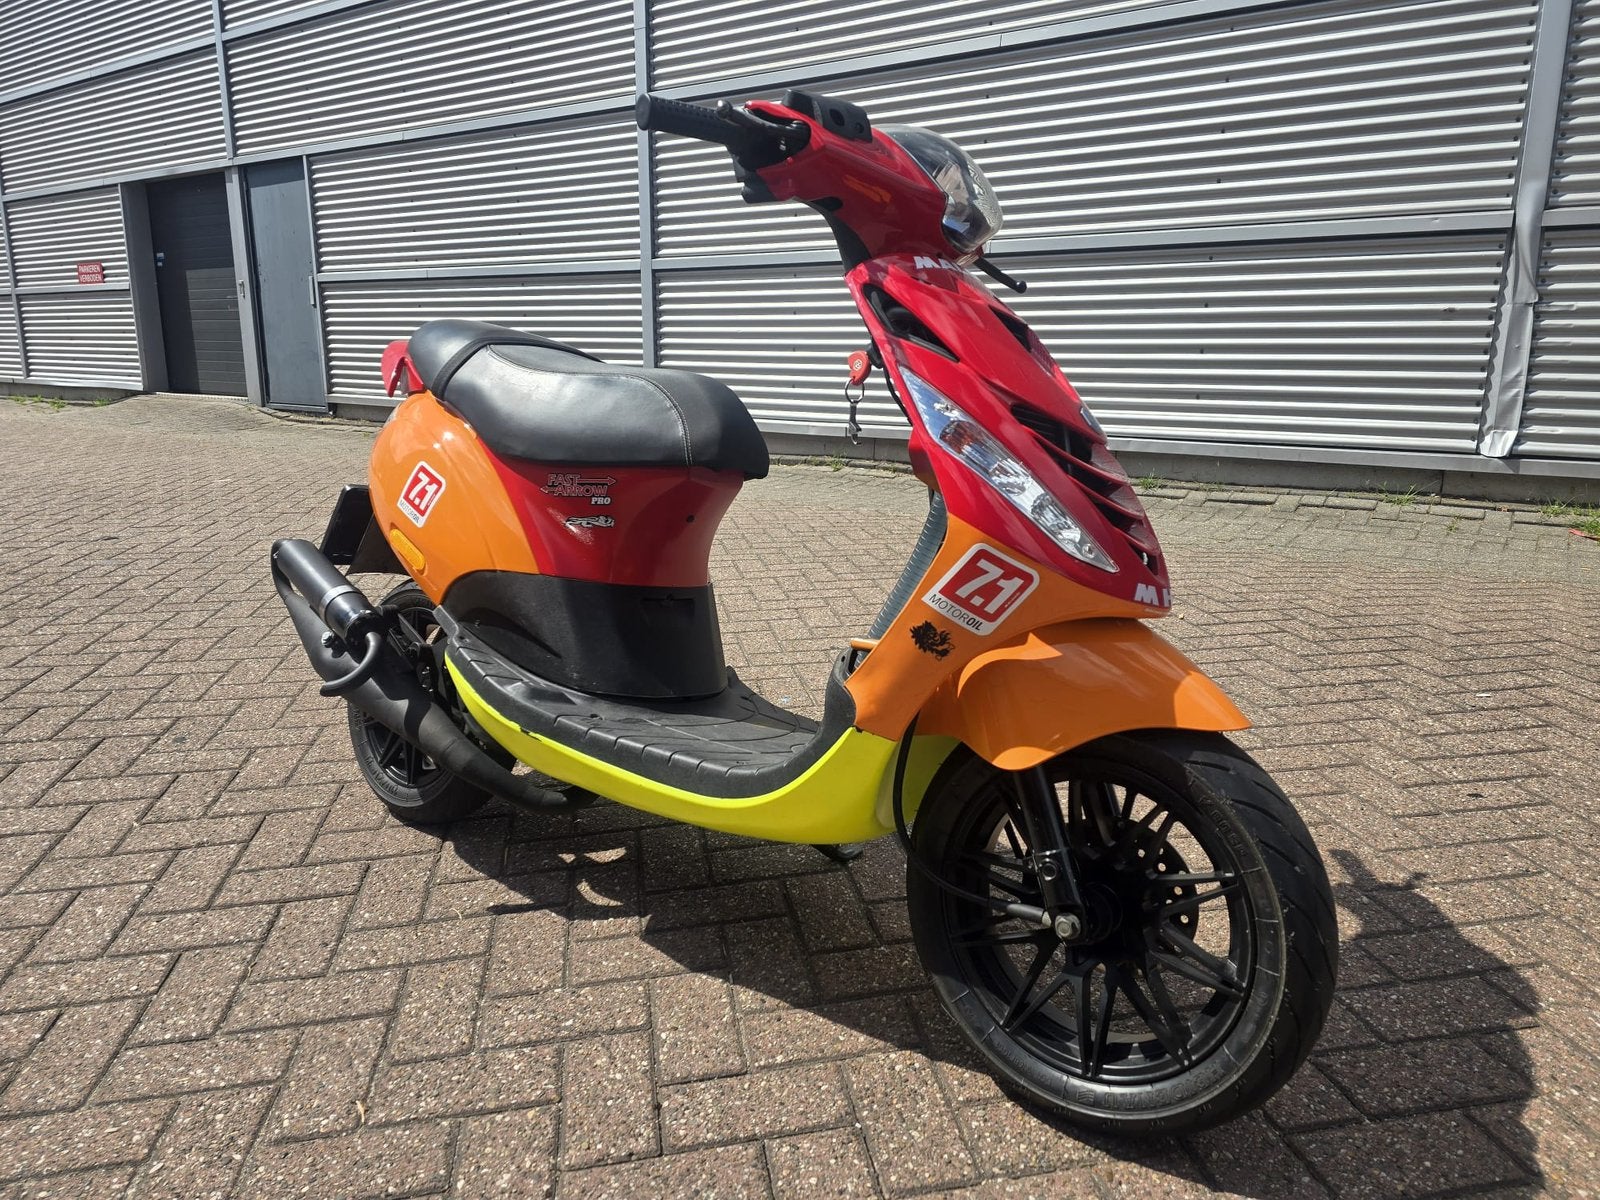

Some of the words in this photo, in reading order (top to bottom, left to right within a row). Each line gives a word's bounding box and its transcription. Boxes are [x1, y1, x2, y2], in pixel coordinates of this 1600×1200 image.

[79, 264, 101, 273] PARKEREN
[79, 273, 103, 282] VERBODEN
[547, 473, 581, 486] FAST
[408, 471, 438, 511] 7.1
[554, 485, 608, 497] ARROW
[591, 497, 611, 505] PRO
[955, 558, 1025, 614] 7.1
[928, 593, 984, 631] MOTOROIL
